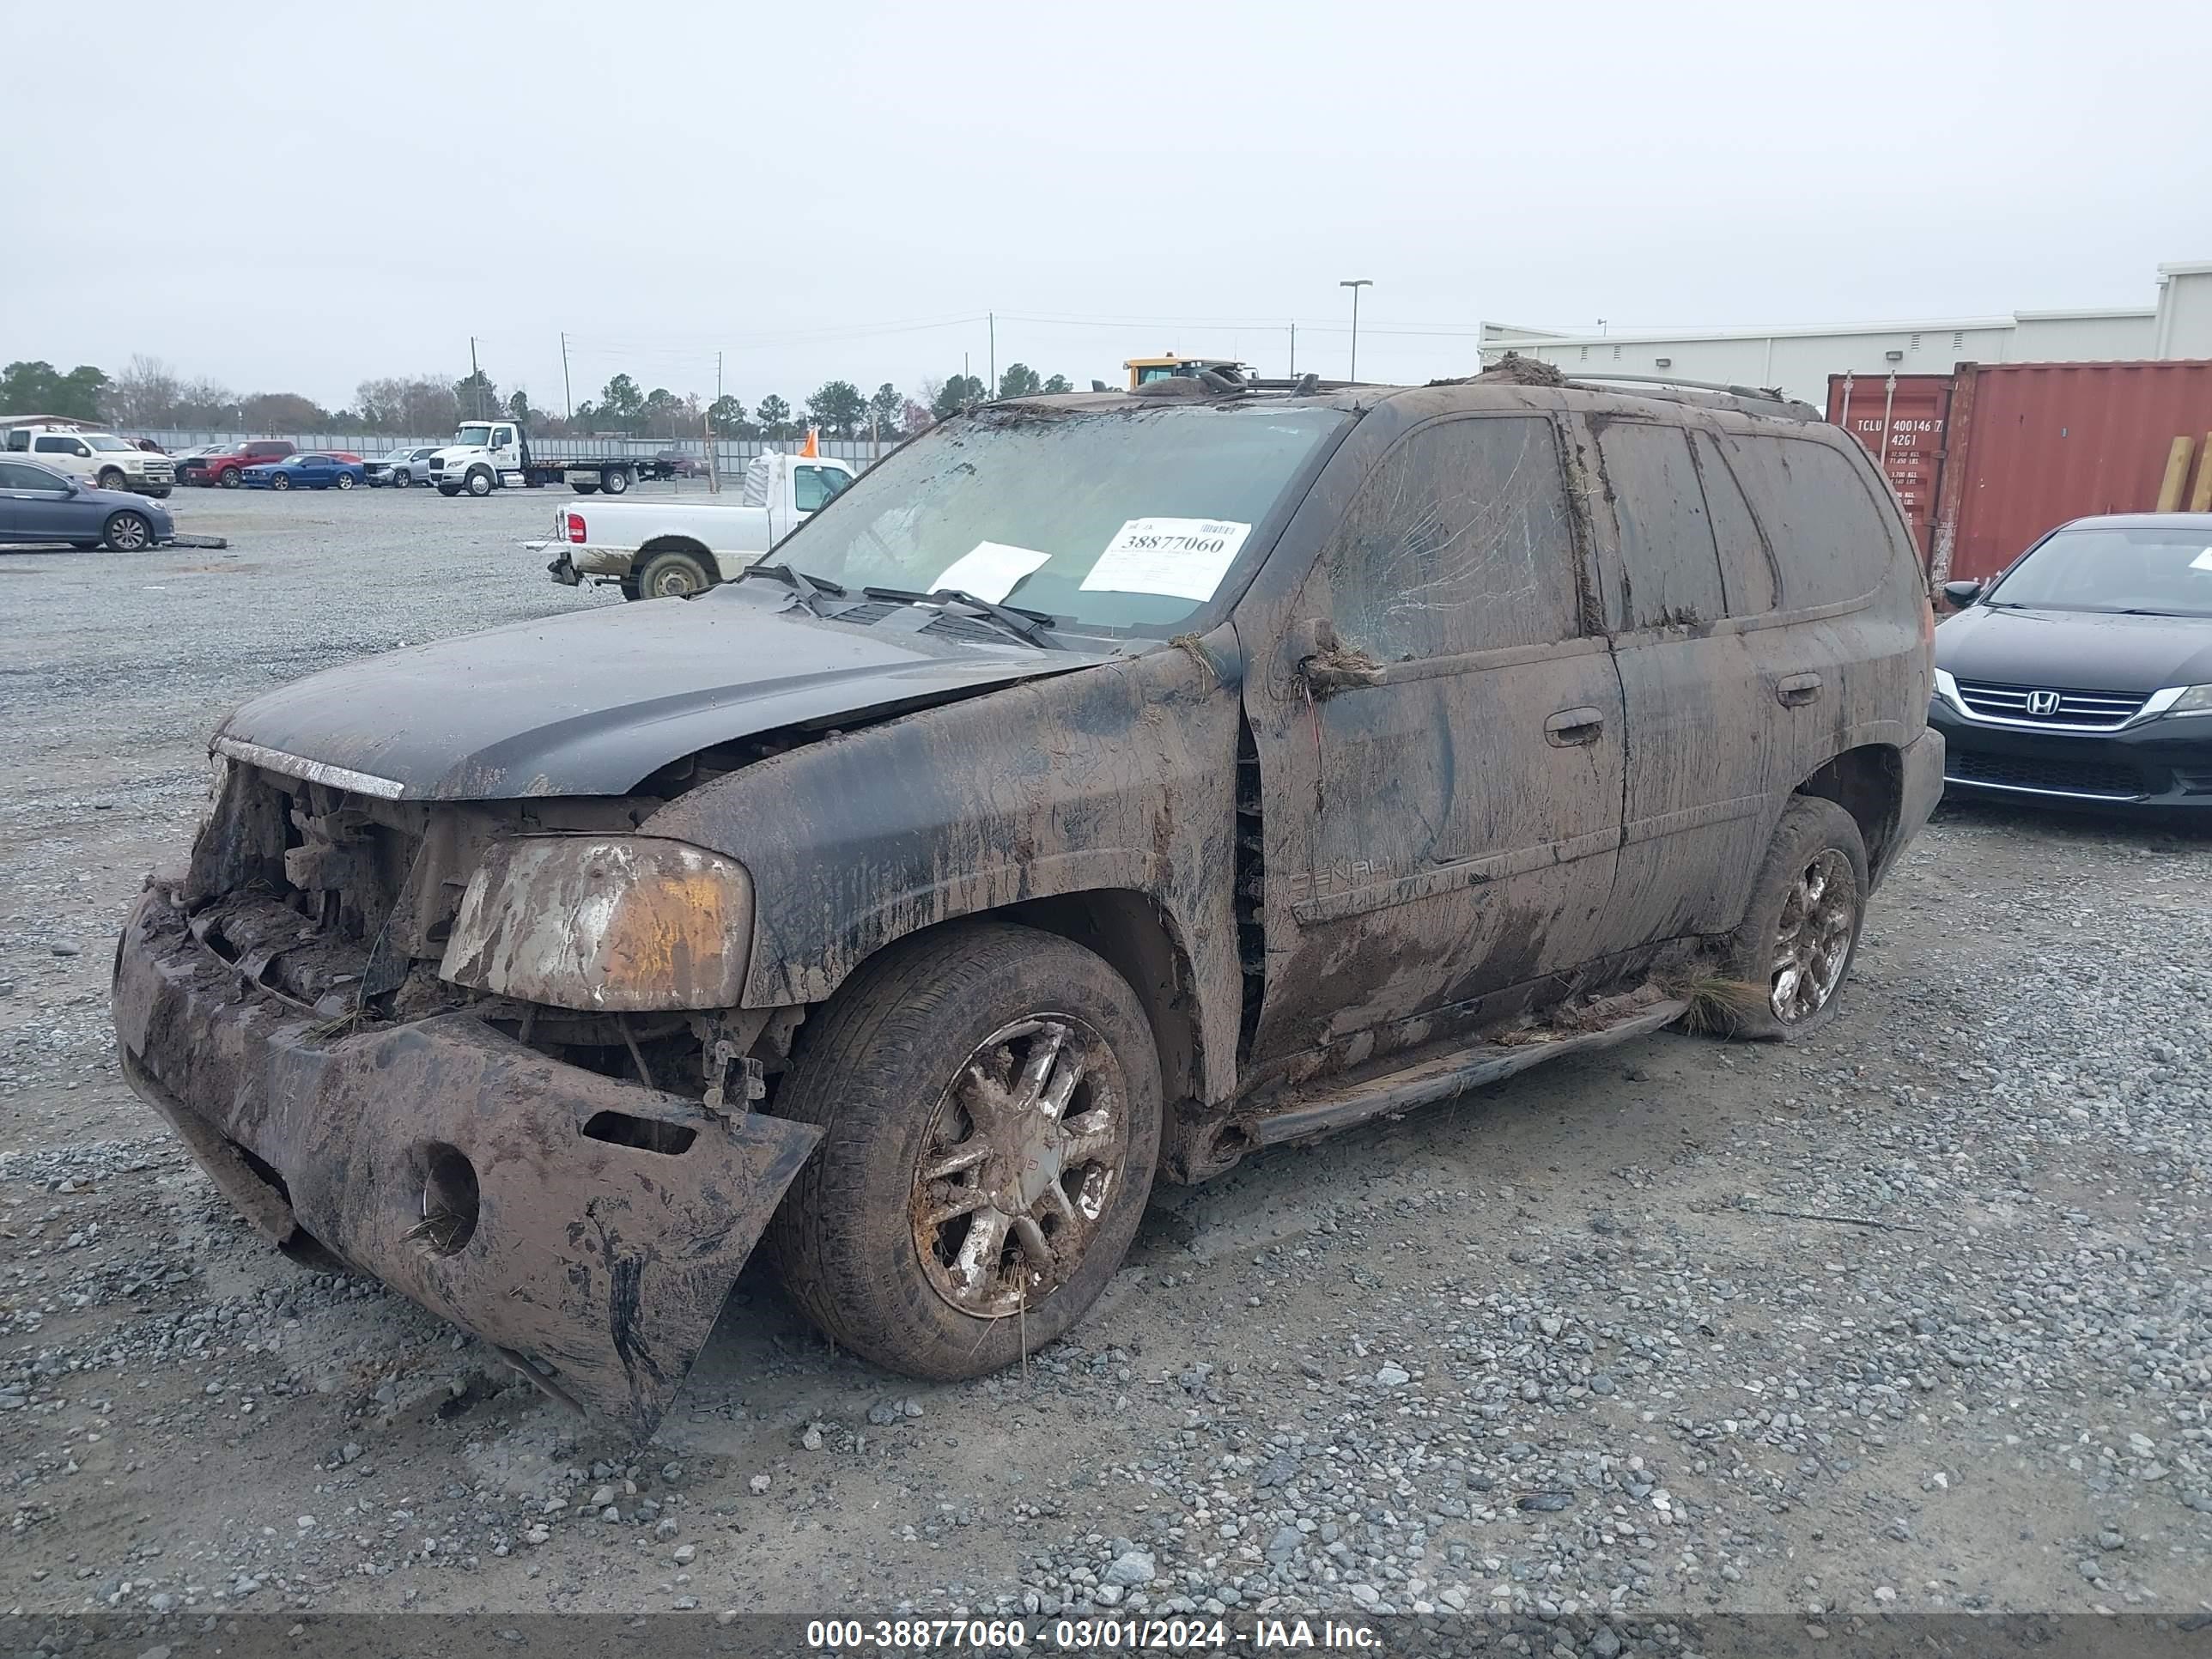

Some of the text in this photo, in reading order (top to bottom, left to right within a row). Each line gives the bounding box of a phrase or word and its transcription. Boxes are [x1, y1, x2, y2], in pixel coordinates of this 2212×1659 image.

[1858, 420, 1882, 431] TCLU
[1893, 420, 1931, 431] 400146
[1121, 535, 1224, 554] 38877060
